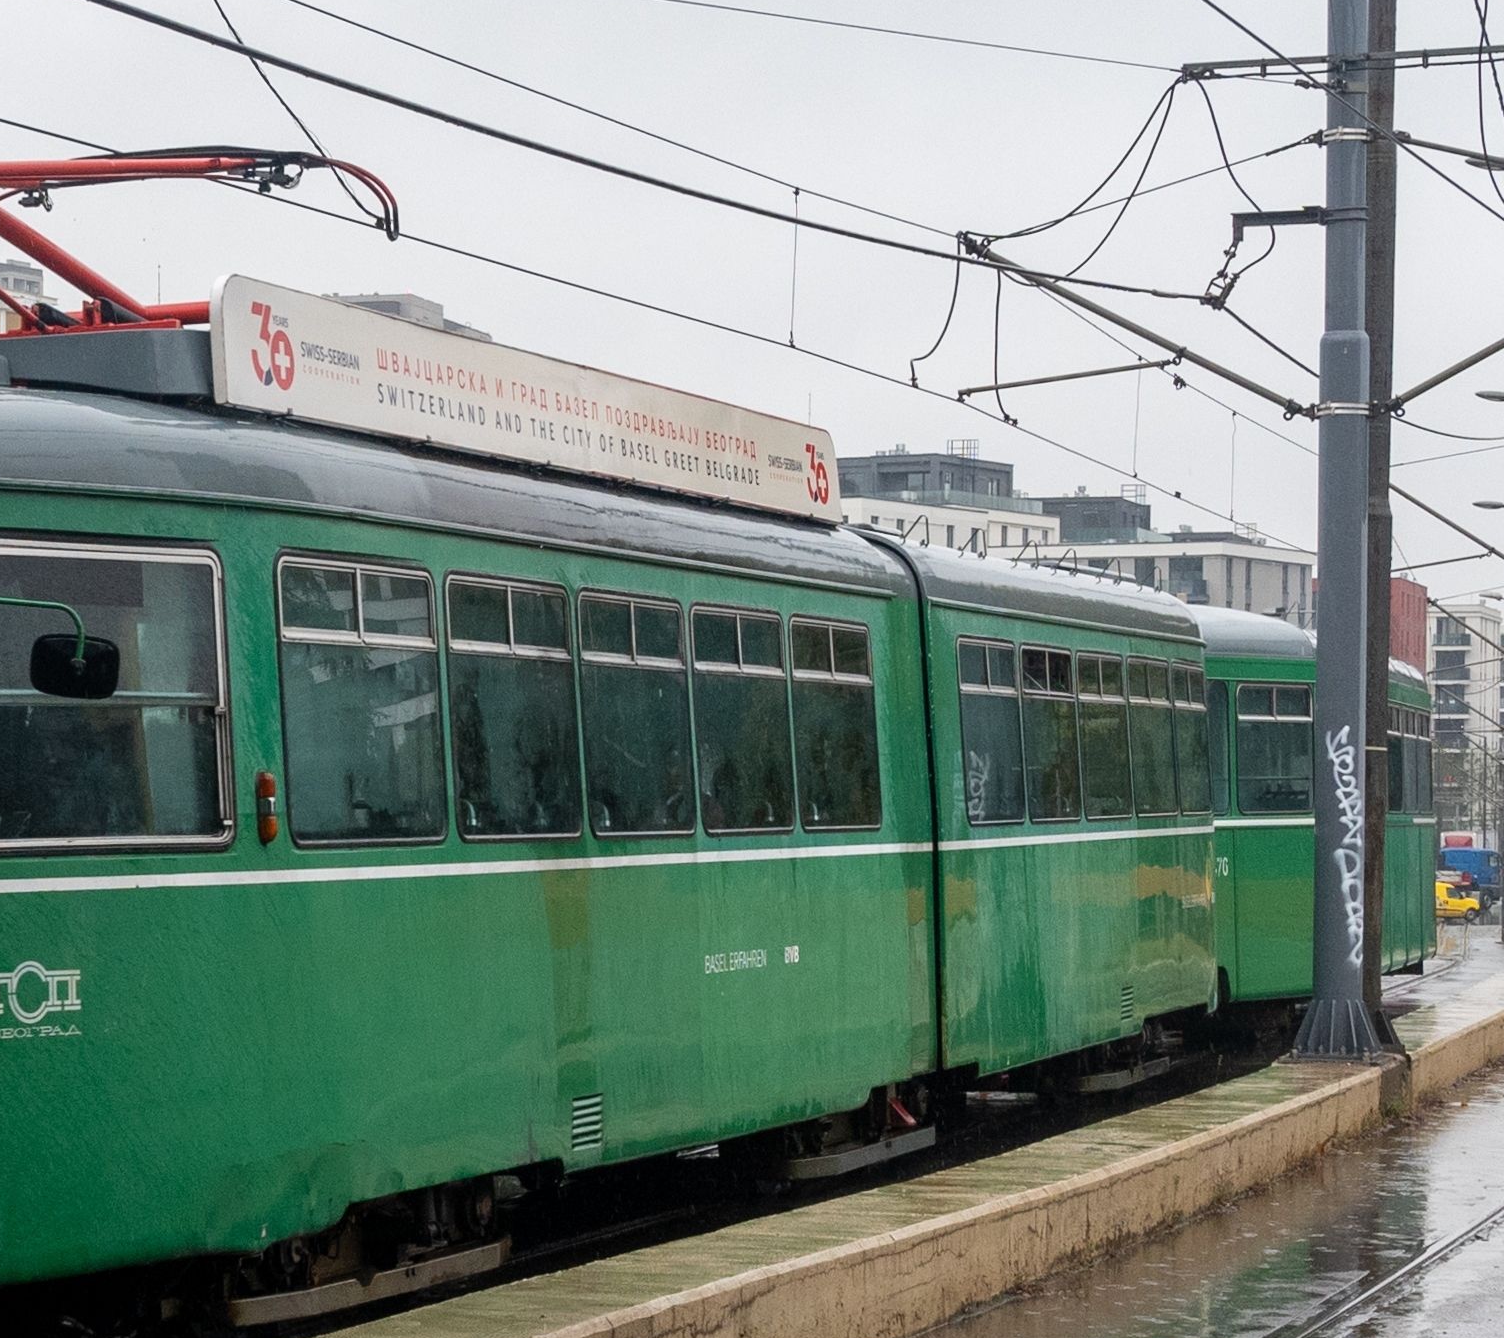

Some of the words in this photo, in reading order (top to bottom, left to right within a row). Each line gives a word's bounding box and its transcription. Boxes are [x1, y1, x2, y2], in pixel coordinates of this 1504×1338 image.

[300, 341, 360, 372] SWISS-SERBIAN
[376, 347, 487, 395] ШВАЈЦАРСКА
[495, 377, 504, 399] И
[511, 381, 548, 412] ГРАД
[555, 391, 599, 422] БАЗЕЛ
[605, 404, 700, 446] ПОЗДРАВЉАЈУ
[705, 430, 758, 462] БЕОГРАД
[377, 382, 486, 426] SWITZERLAND
[495, 410, 523, 434] AND
[530, 418, 556, 442] THE
[563, 424, 592, 450] CITY
[599, 432, 614, 454] OF
[621, 438, 658, 465] BASEL
[664, 449, 700, 474] GREET
[705, 458, 761, 487] BELGRADE
[704, 953, 728, 975] BASEL
